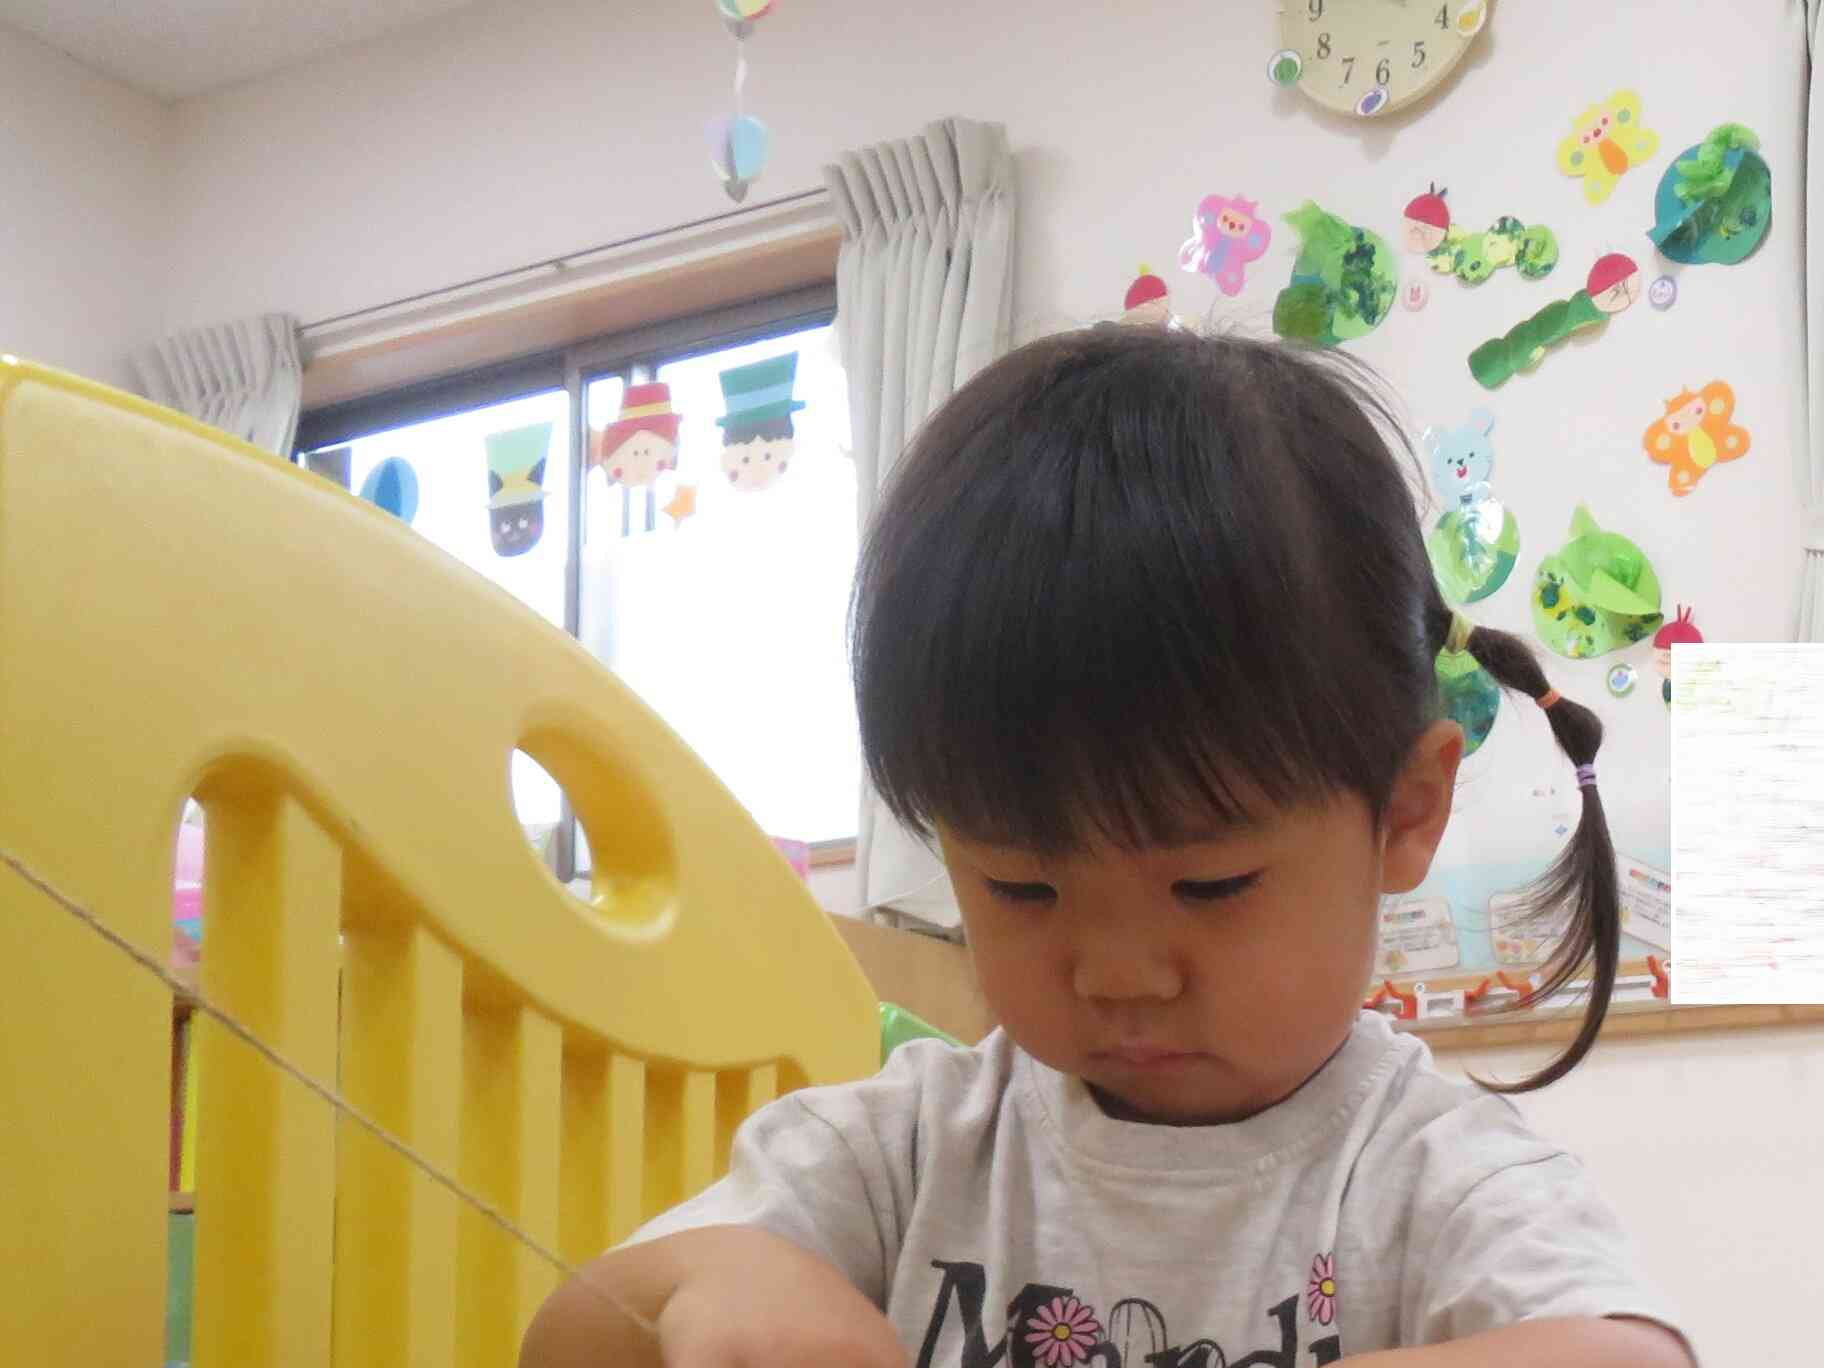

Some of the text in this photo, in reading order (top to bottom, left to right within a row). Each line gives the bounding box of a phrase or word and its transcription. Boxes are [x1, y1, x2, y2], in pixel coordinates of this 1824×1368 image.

[1434, 4, 1449, 30] 4
[1316, 33, 1331, 60] 8
[1411, 41, 1426, 69] 5
[1341, 57, 1355, 84] 7
[1375, 59, 1391, 86] 6
